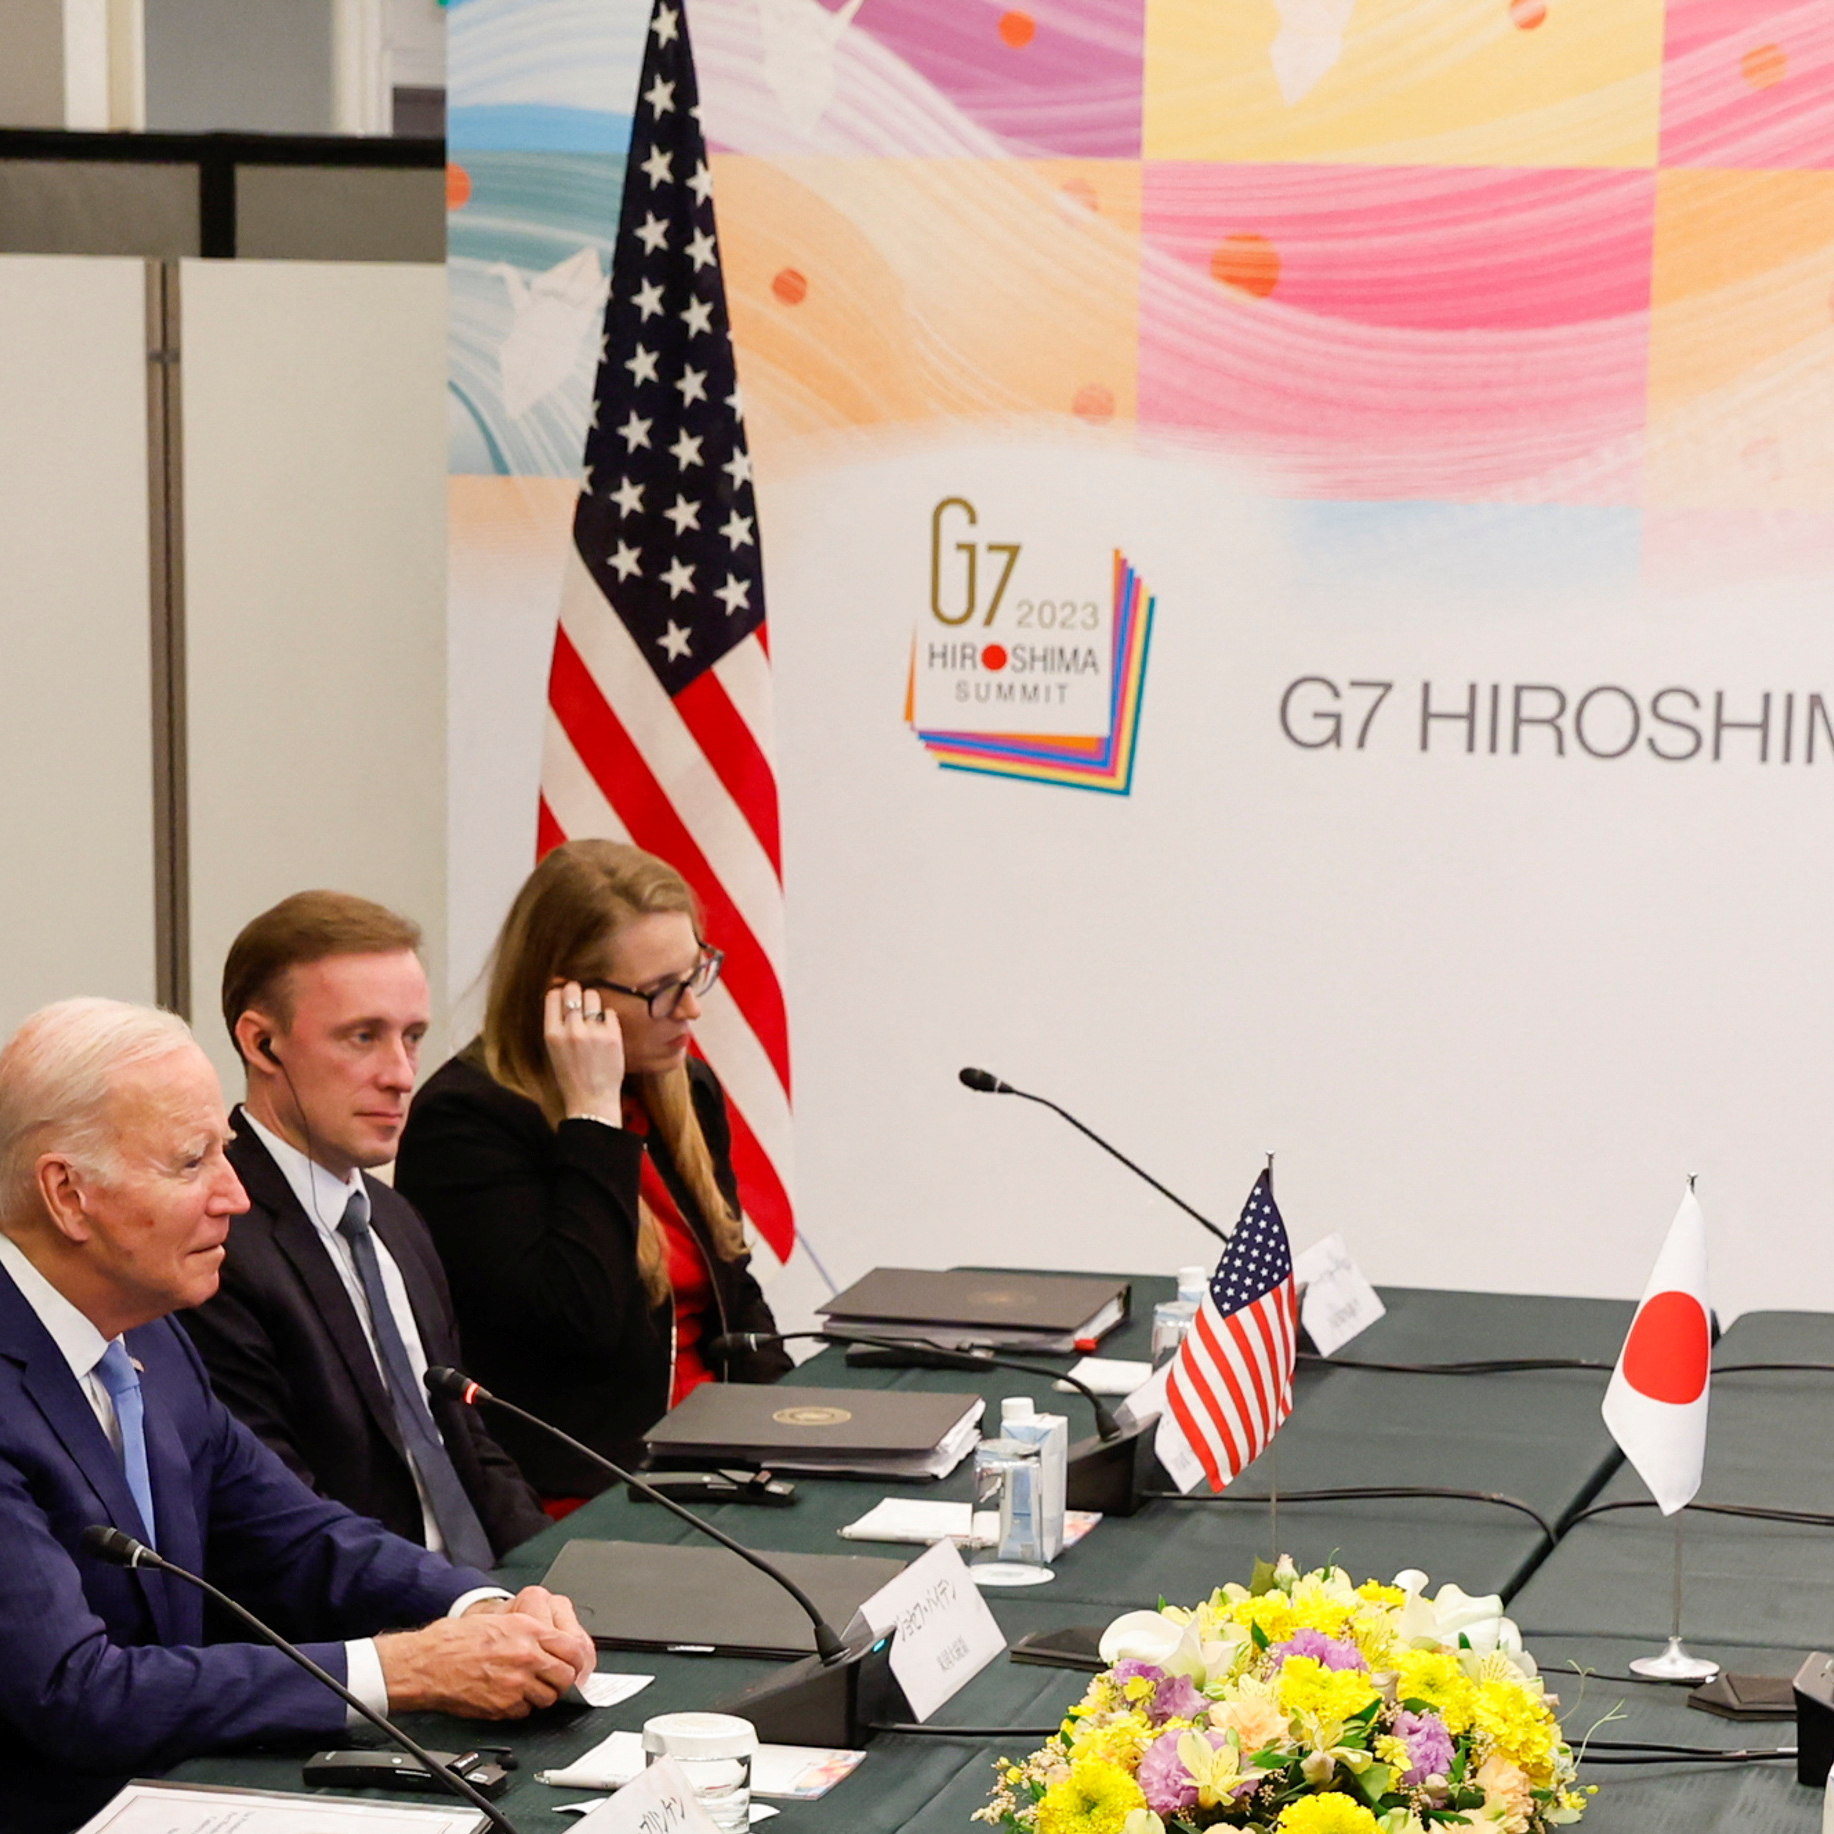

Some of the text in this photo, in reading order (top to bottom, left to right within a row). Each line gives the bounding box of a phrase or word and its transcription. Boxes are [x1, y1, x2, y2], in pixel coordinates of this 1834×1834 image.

[930, 496, 1101, 631] G7 2023
[955, 680, 1070, 704] SUMMIT
[1279, 675, 1394, 750] G7
